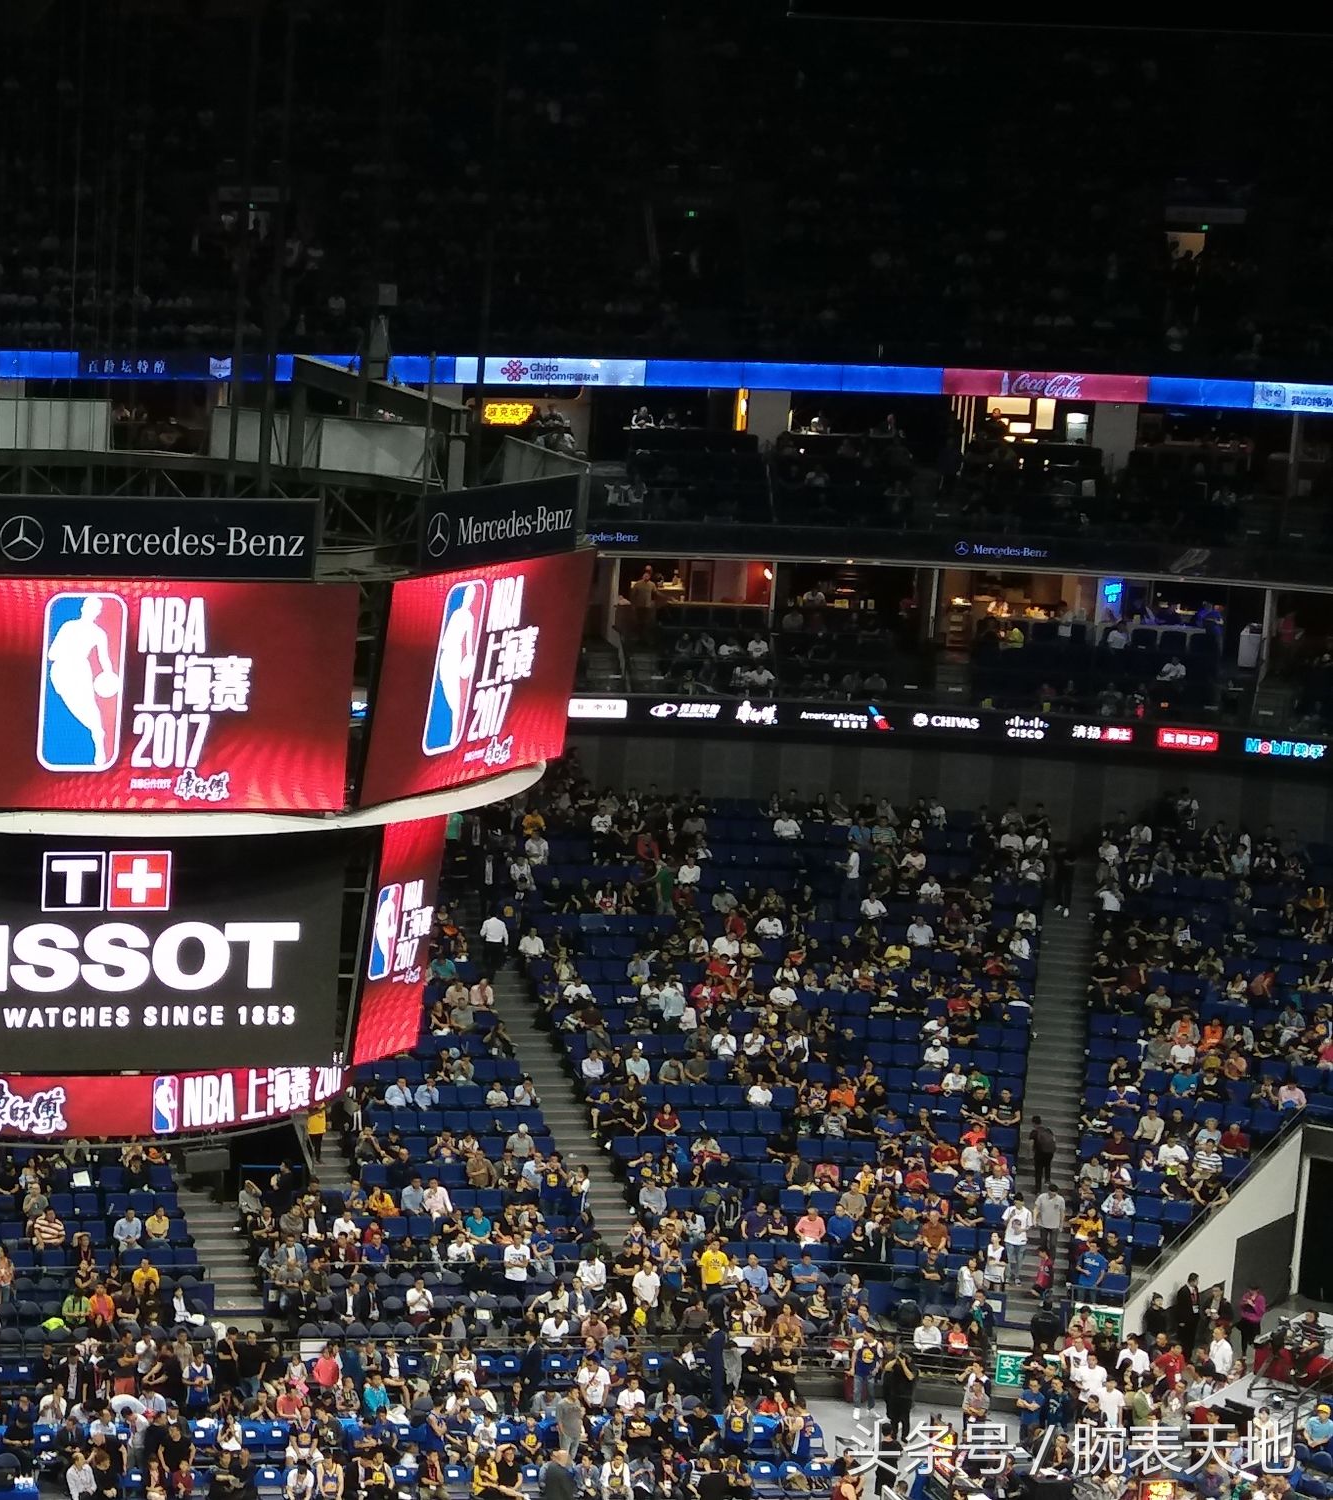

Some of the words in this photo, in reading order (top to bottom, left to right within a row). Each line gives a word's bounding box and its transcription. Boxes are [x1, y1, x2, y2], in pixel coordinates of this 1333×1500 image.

[530, 362, 559, 372] China
[530, 372, 567, 381] unicom
[60, 524, 305, 557] Mercedes-Benz
[457, 505, 573, 546] Mercedes-Benz
[973, 544, 1048, 558] Mercedes-Benz
[486, 575, 524, 633] NBA
[138, 597, 205, 654] NBA
[476, 625, 539, 689] 上海赛
[132, 655, 252, 712] 上海赛
[467, 683, 513, 742] 2017
[801, 711, 838, 721] American
[838, 712, 868, 722] Airlines
[931, 715, 980, 730] CHIVAS
[130, 713, 210, 768] 2017
[1245, 737, 1292, 756] Mobil
[4, 1007, 130, 1029] WATCHES
[142, 1006, 224, 1027] SINCE
[238, 1005, 296, 1026] 1853
[182, 1073, 235, 1127] NBA
[240, 1066, 311, 1121] 上海赛
